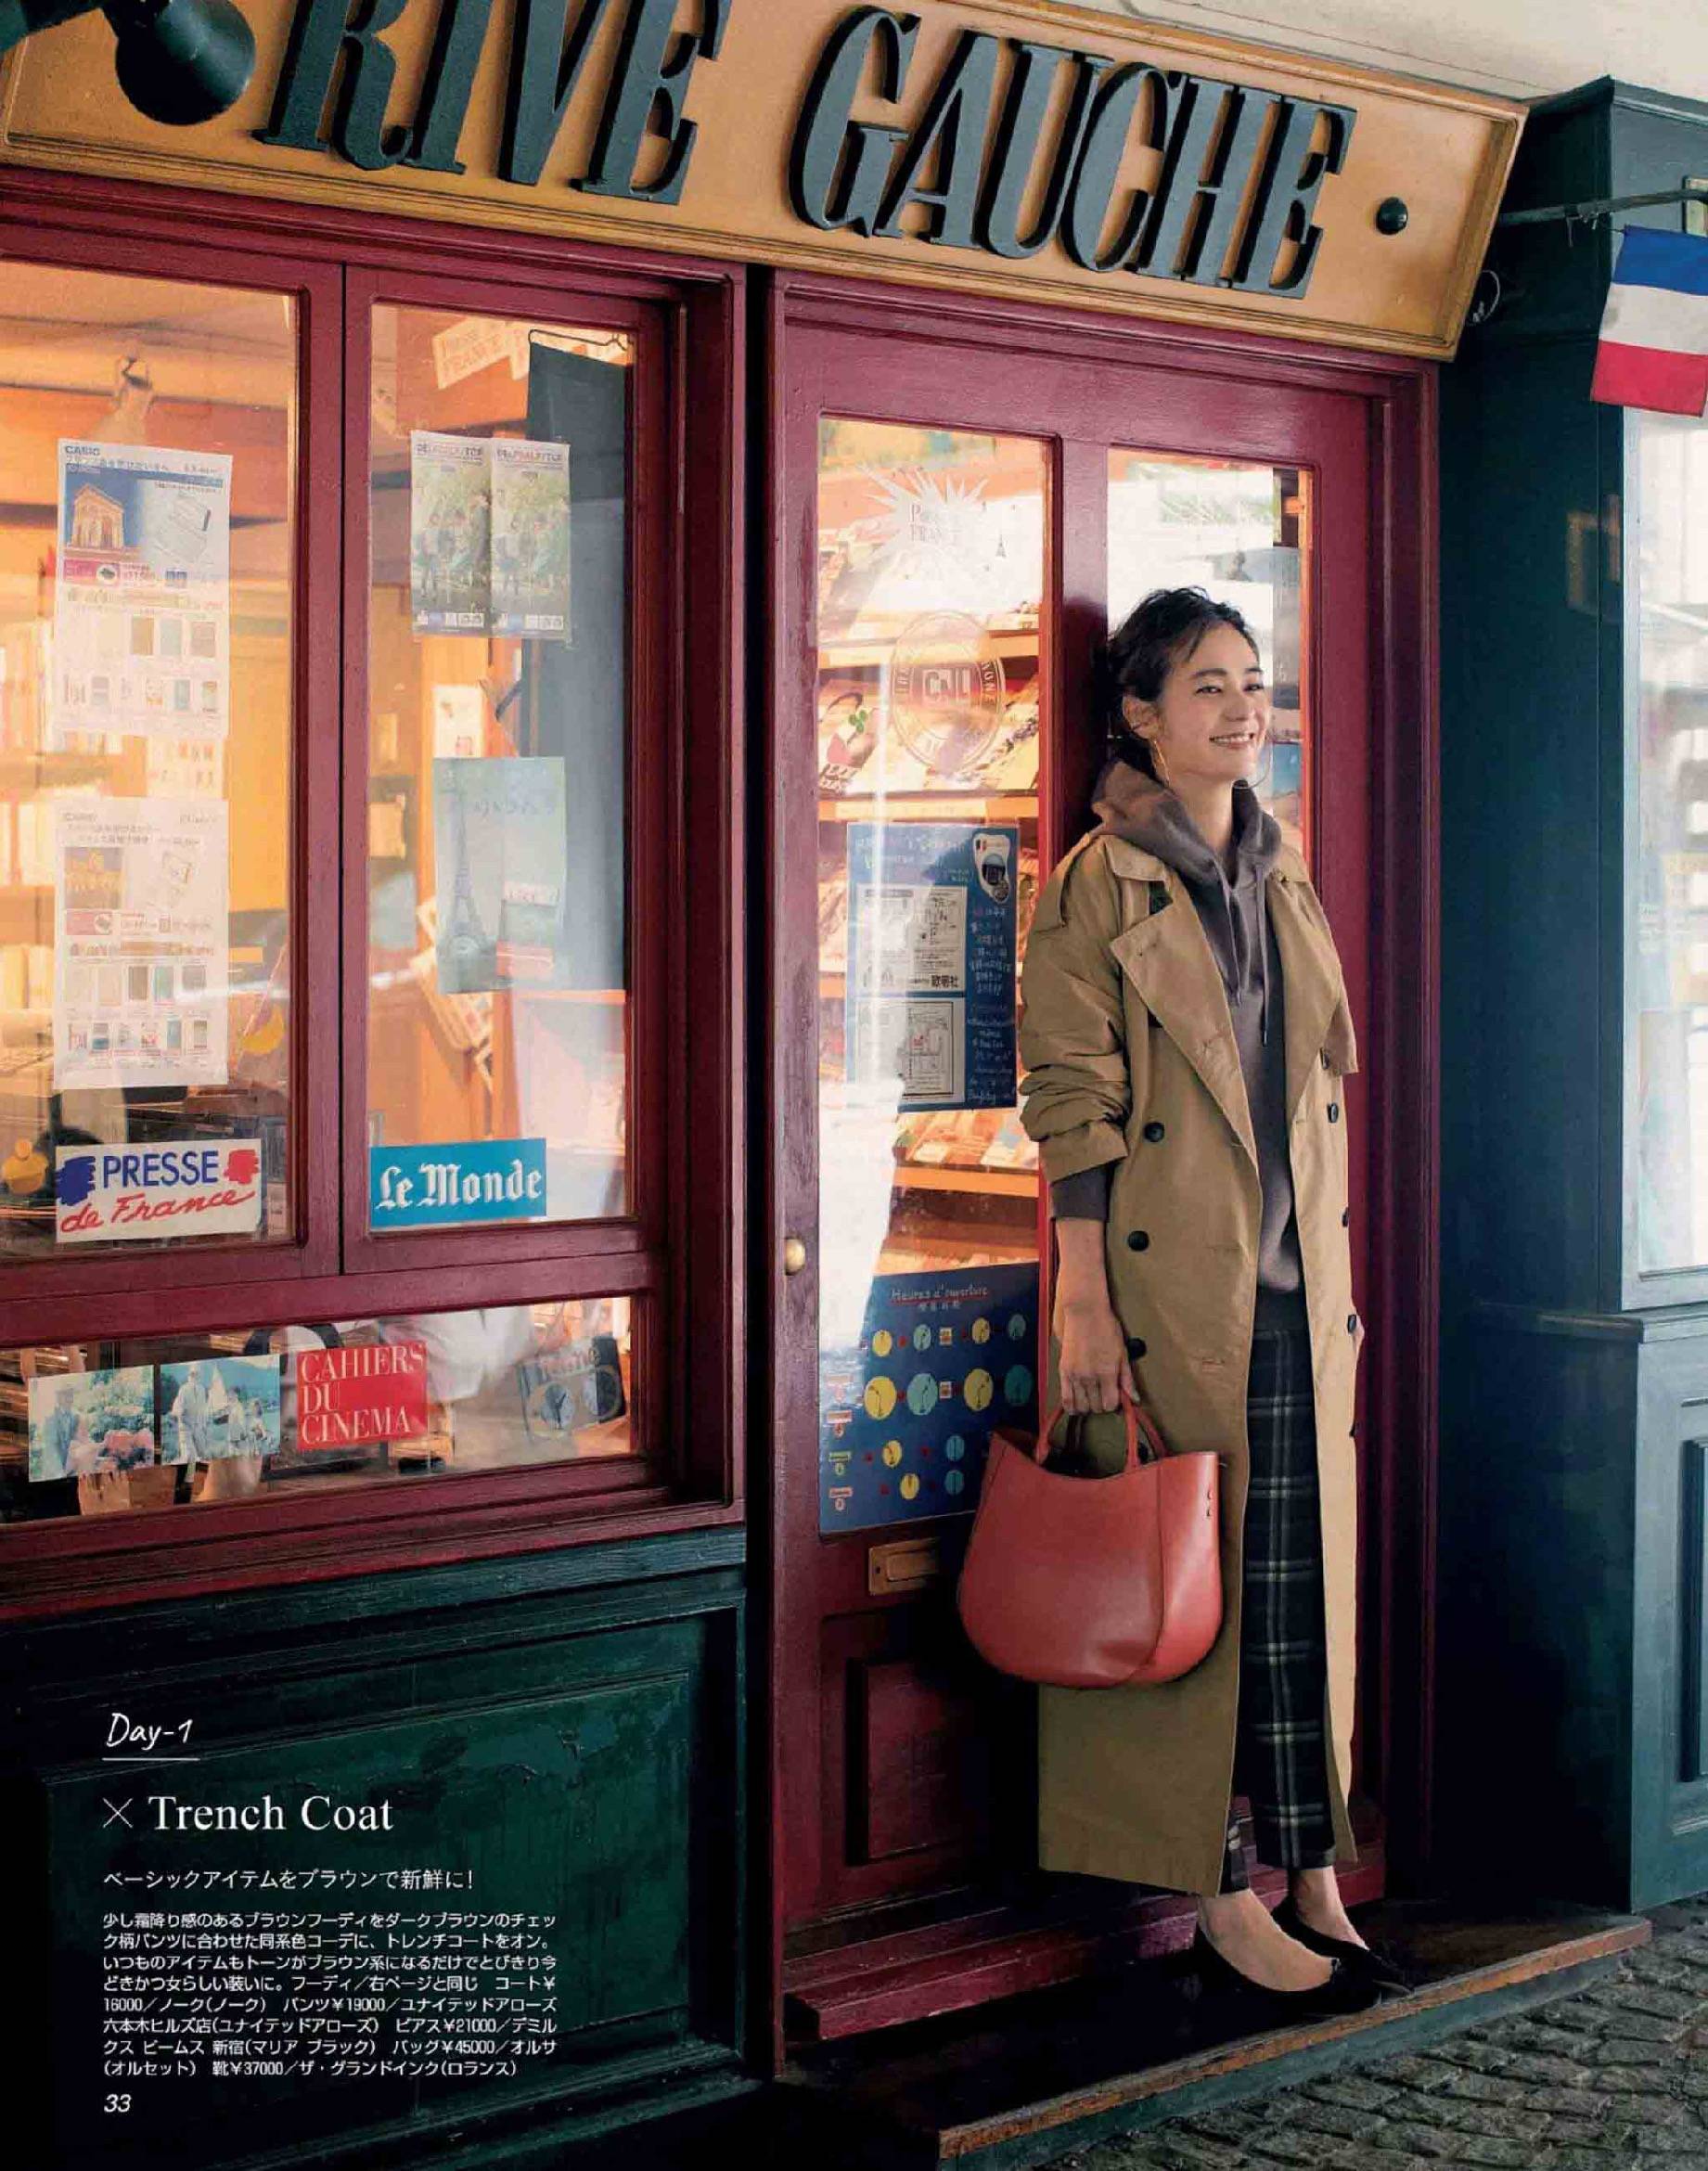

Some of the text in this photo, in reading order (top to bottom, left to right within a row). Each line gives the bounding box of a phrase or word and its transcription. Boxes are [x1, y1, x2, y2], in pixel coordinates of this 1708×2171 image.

[251, 0, 1357, 299] RIVE GAUCHE
[103, 1150, 219, 1188] PRESSE
[376, 1158, 543, 1210] Le Monde
[61, 1189, 256, 1233] de France
[301, 1343, 424, 1383] CAHIERS
[302, 1381, 340, 1415] DU
[301, 1406, 412, 1445] CINEMA
